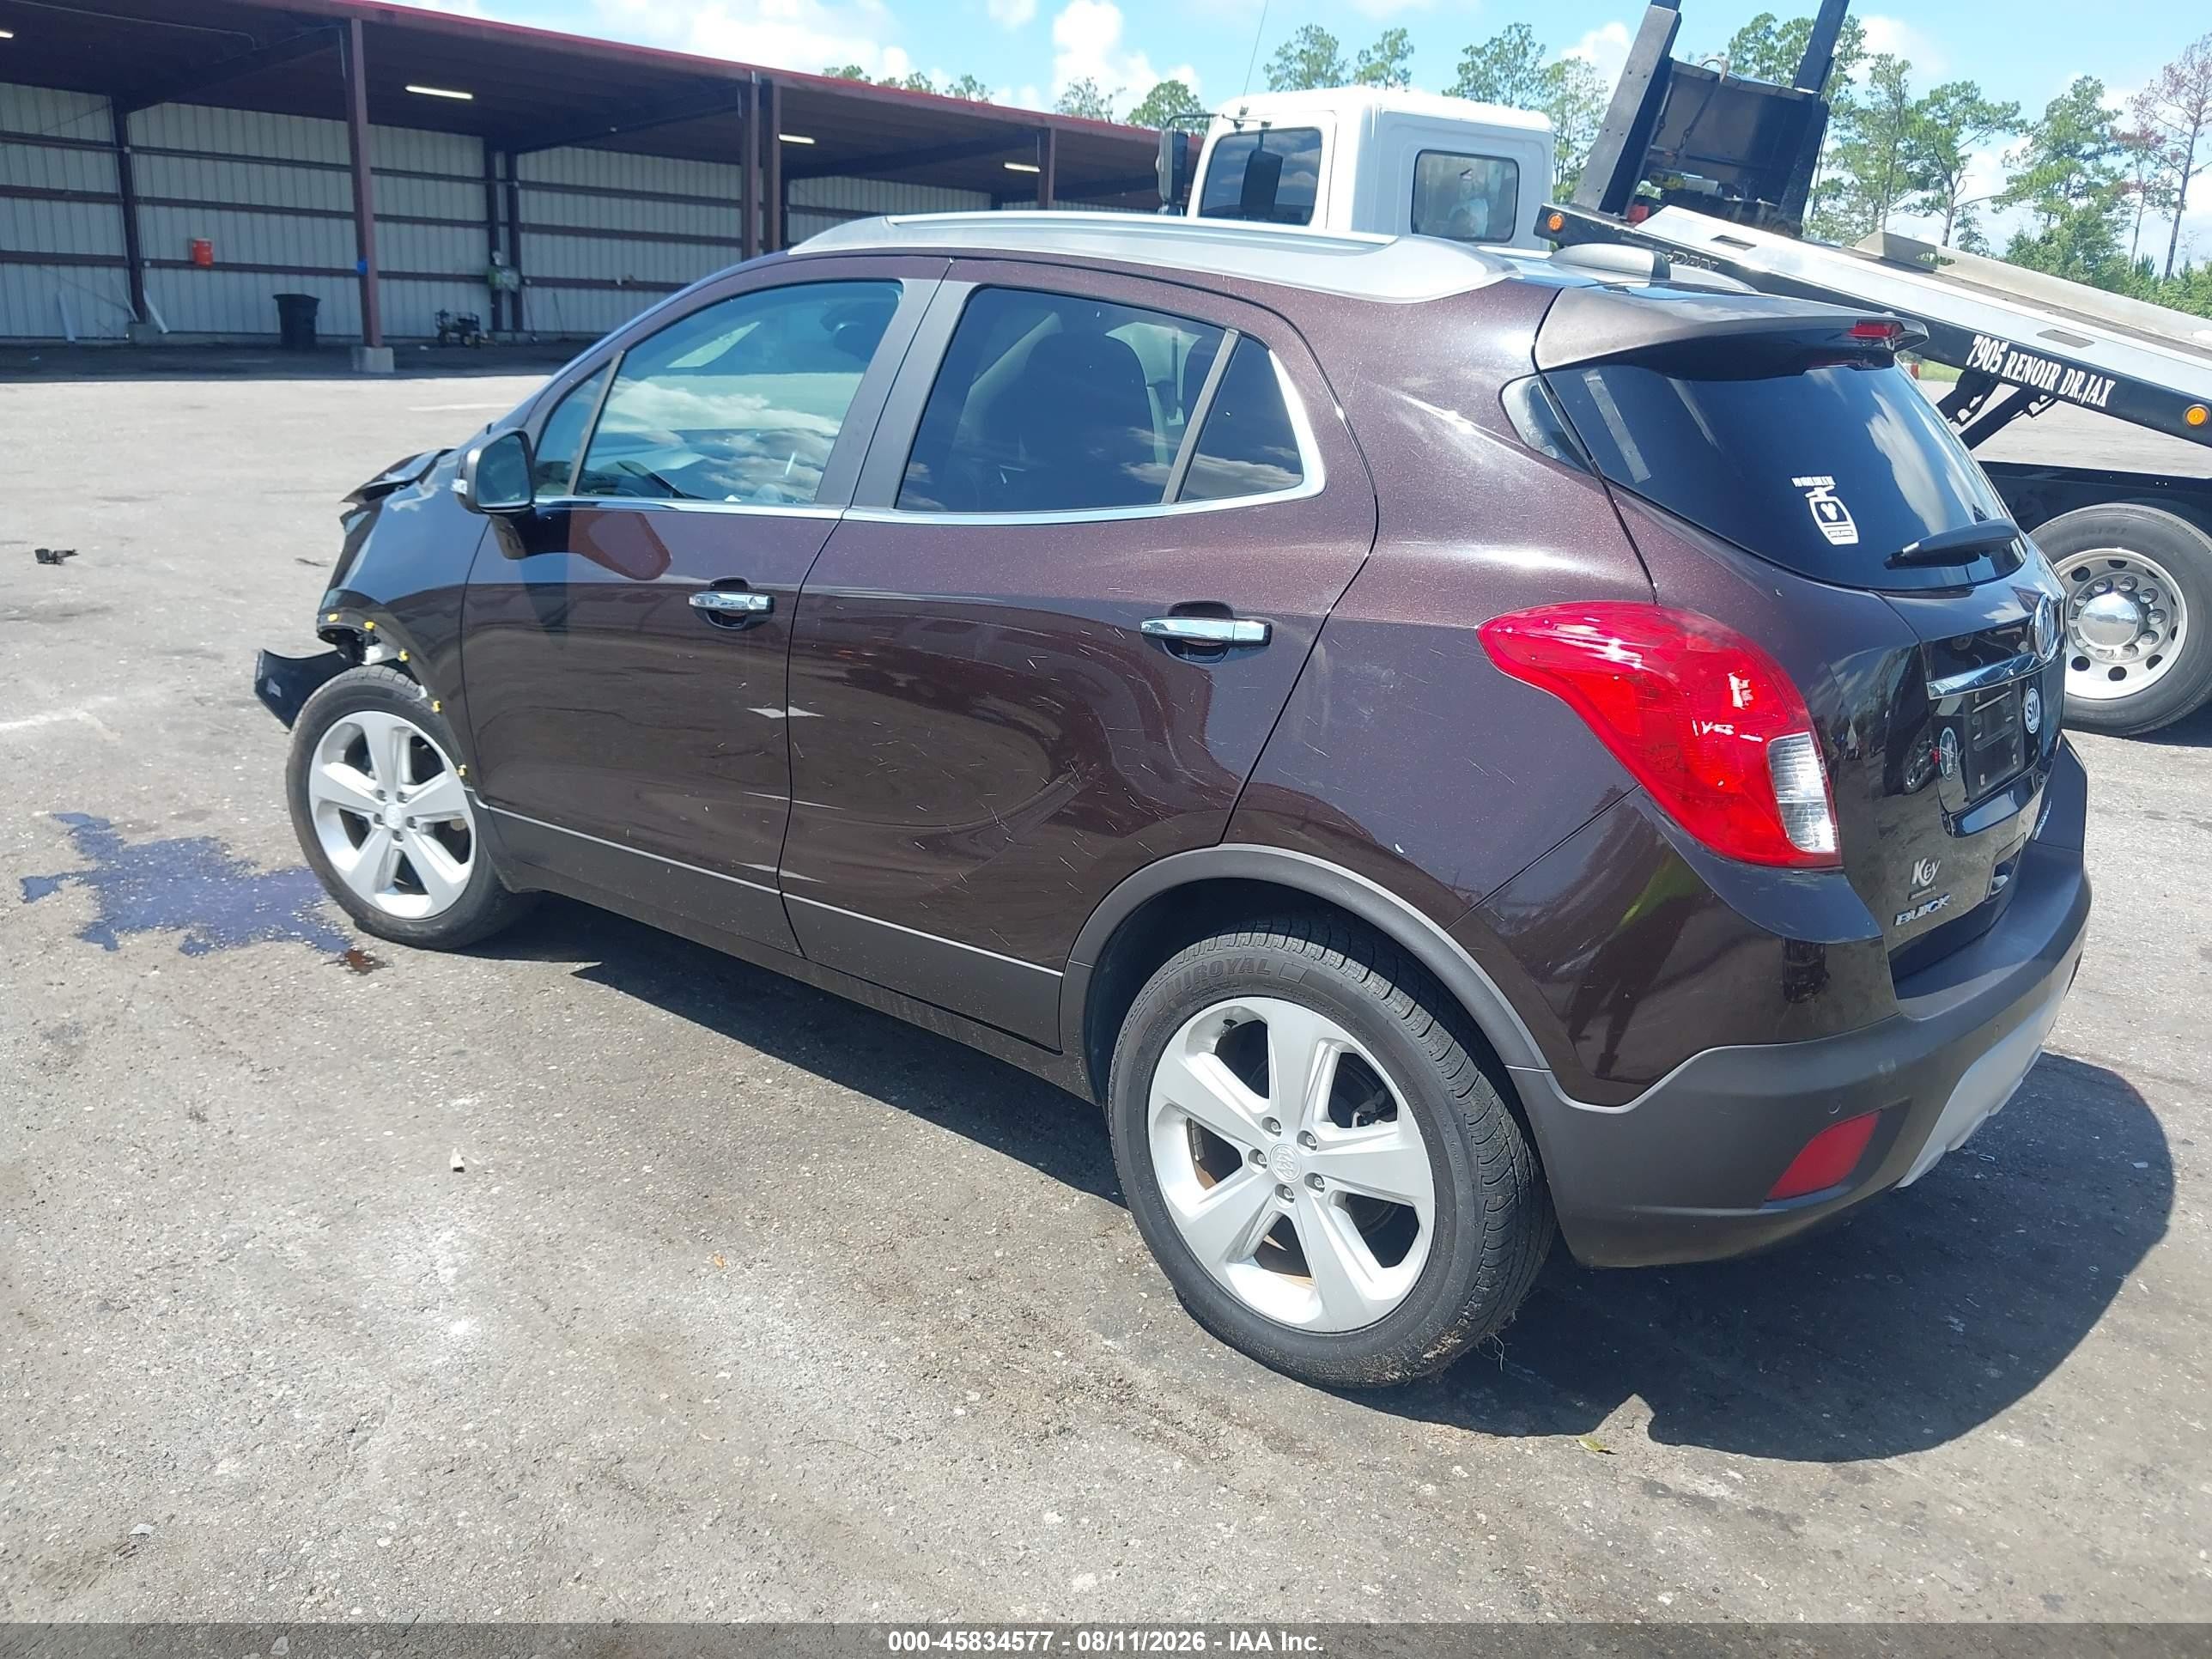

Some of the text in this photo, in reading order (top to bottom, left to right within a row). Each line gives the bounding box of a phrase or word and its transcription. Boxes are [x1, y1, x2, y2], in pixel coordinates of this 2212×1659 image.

[1966, 334, 2009, 374] 7905
[2001, 350, 2062, 392] RENOIR
[2027, 699, 2039, 722] SM
[1894, 894, 1951, 927] BUICK
[1152, 957, 1273, 1012] UNIROYAL
